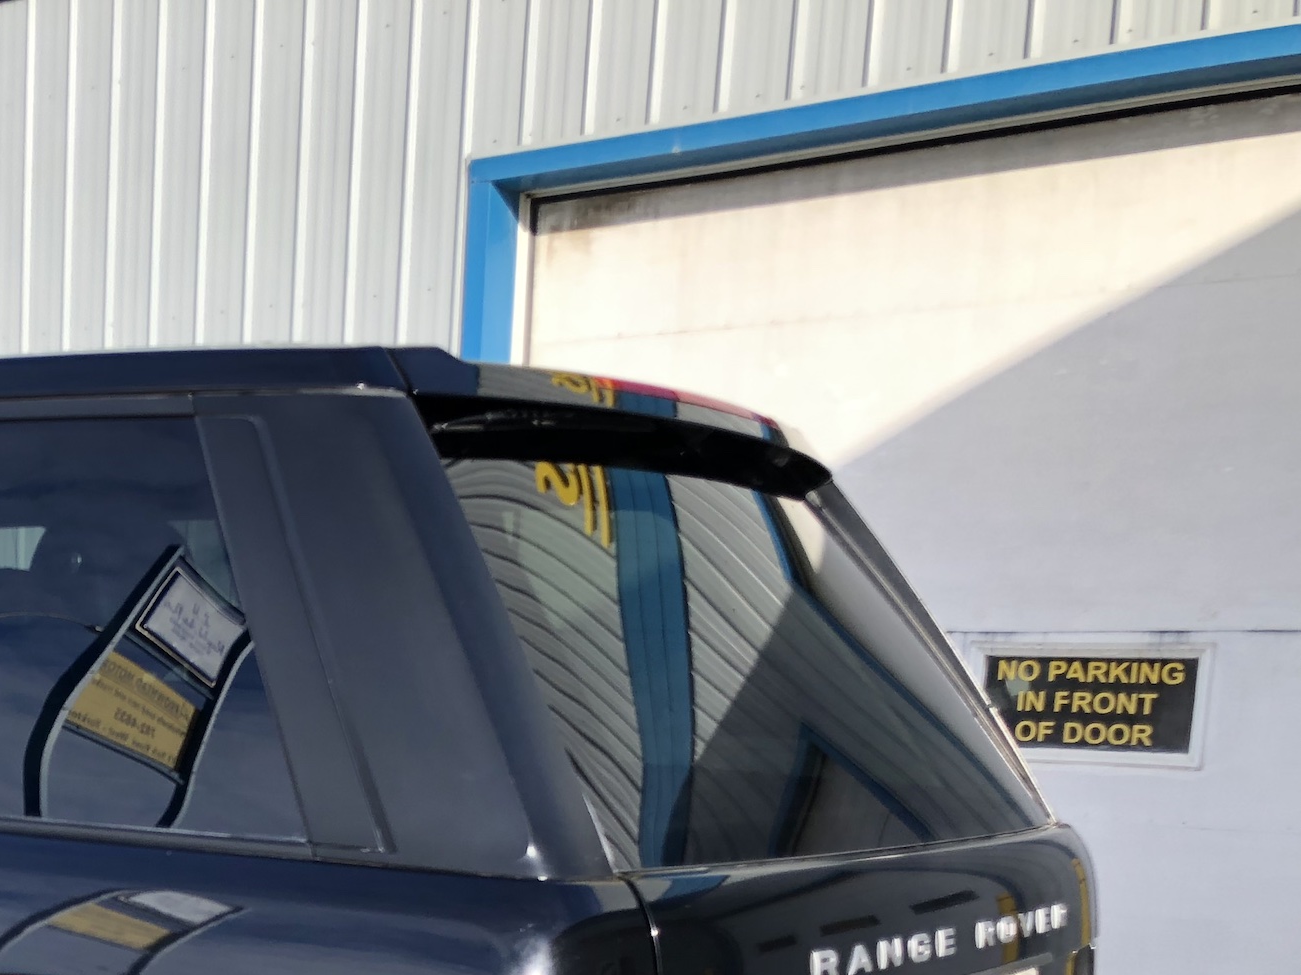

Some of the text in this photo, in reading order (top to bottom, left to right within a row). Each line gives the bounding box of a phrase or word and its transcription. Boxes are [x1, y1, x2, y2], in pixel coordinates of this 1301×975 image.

[997, 660, 1186, 686] NO PARKING
[1016, 690, 1159, 715] IN FRONT
[1014, 720, 1154, 746] OF DOOR
[974, 903, 1068, 949] ROVER
